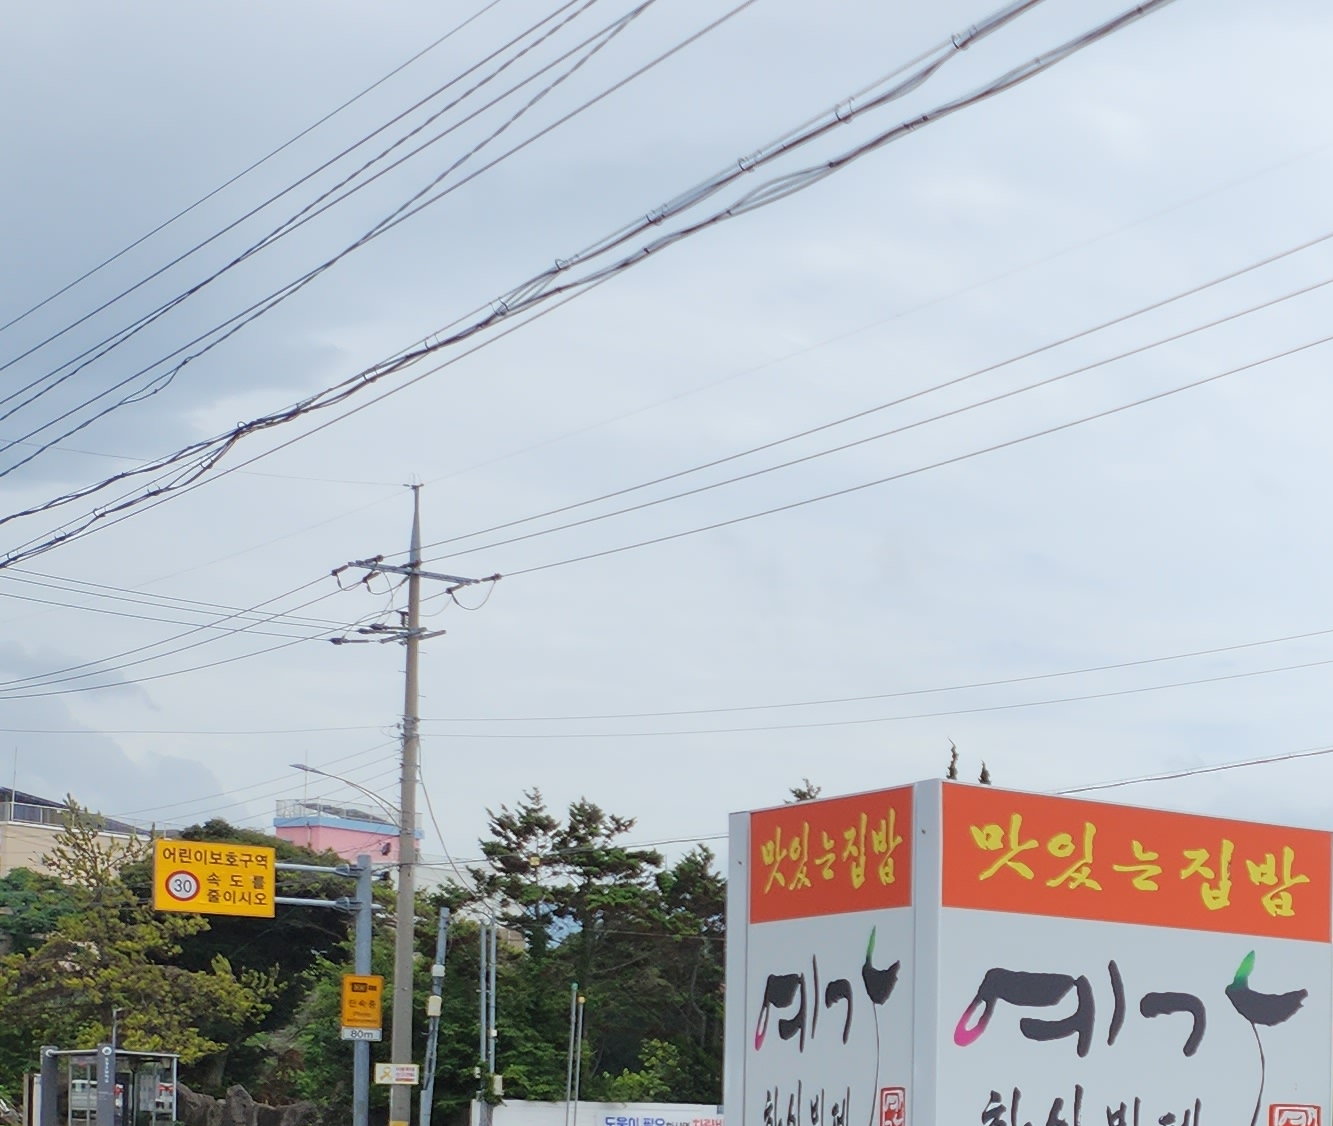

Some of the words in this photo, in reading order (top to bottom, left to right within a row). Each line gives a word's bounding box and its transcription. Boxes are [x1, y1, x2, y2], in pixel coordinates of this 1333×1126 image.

[162, 847, 269, 870] 어린이보호구역
[761, 807, 903, 895] 맛있는집밥
[969, 812, 1311, 918] 맛있는집밥
[173, 878, 193, 894] 30
[206, 888, 268, 906] 줄이시오
[350, 1029, 374, 1039] 80m
